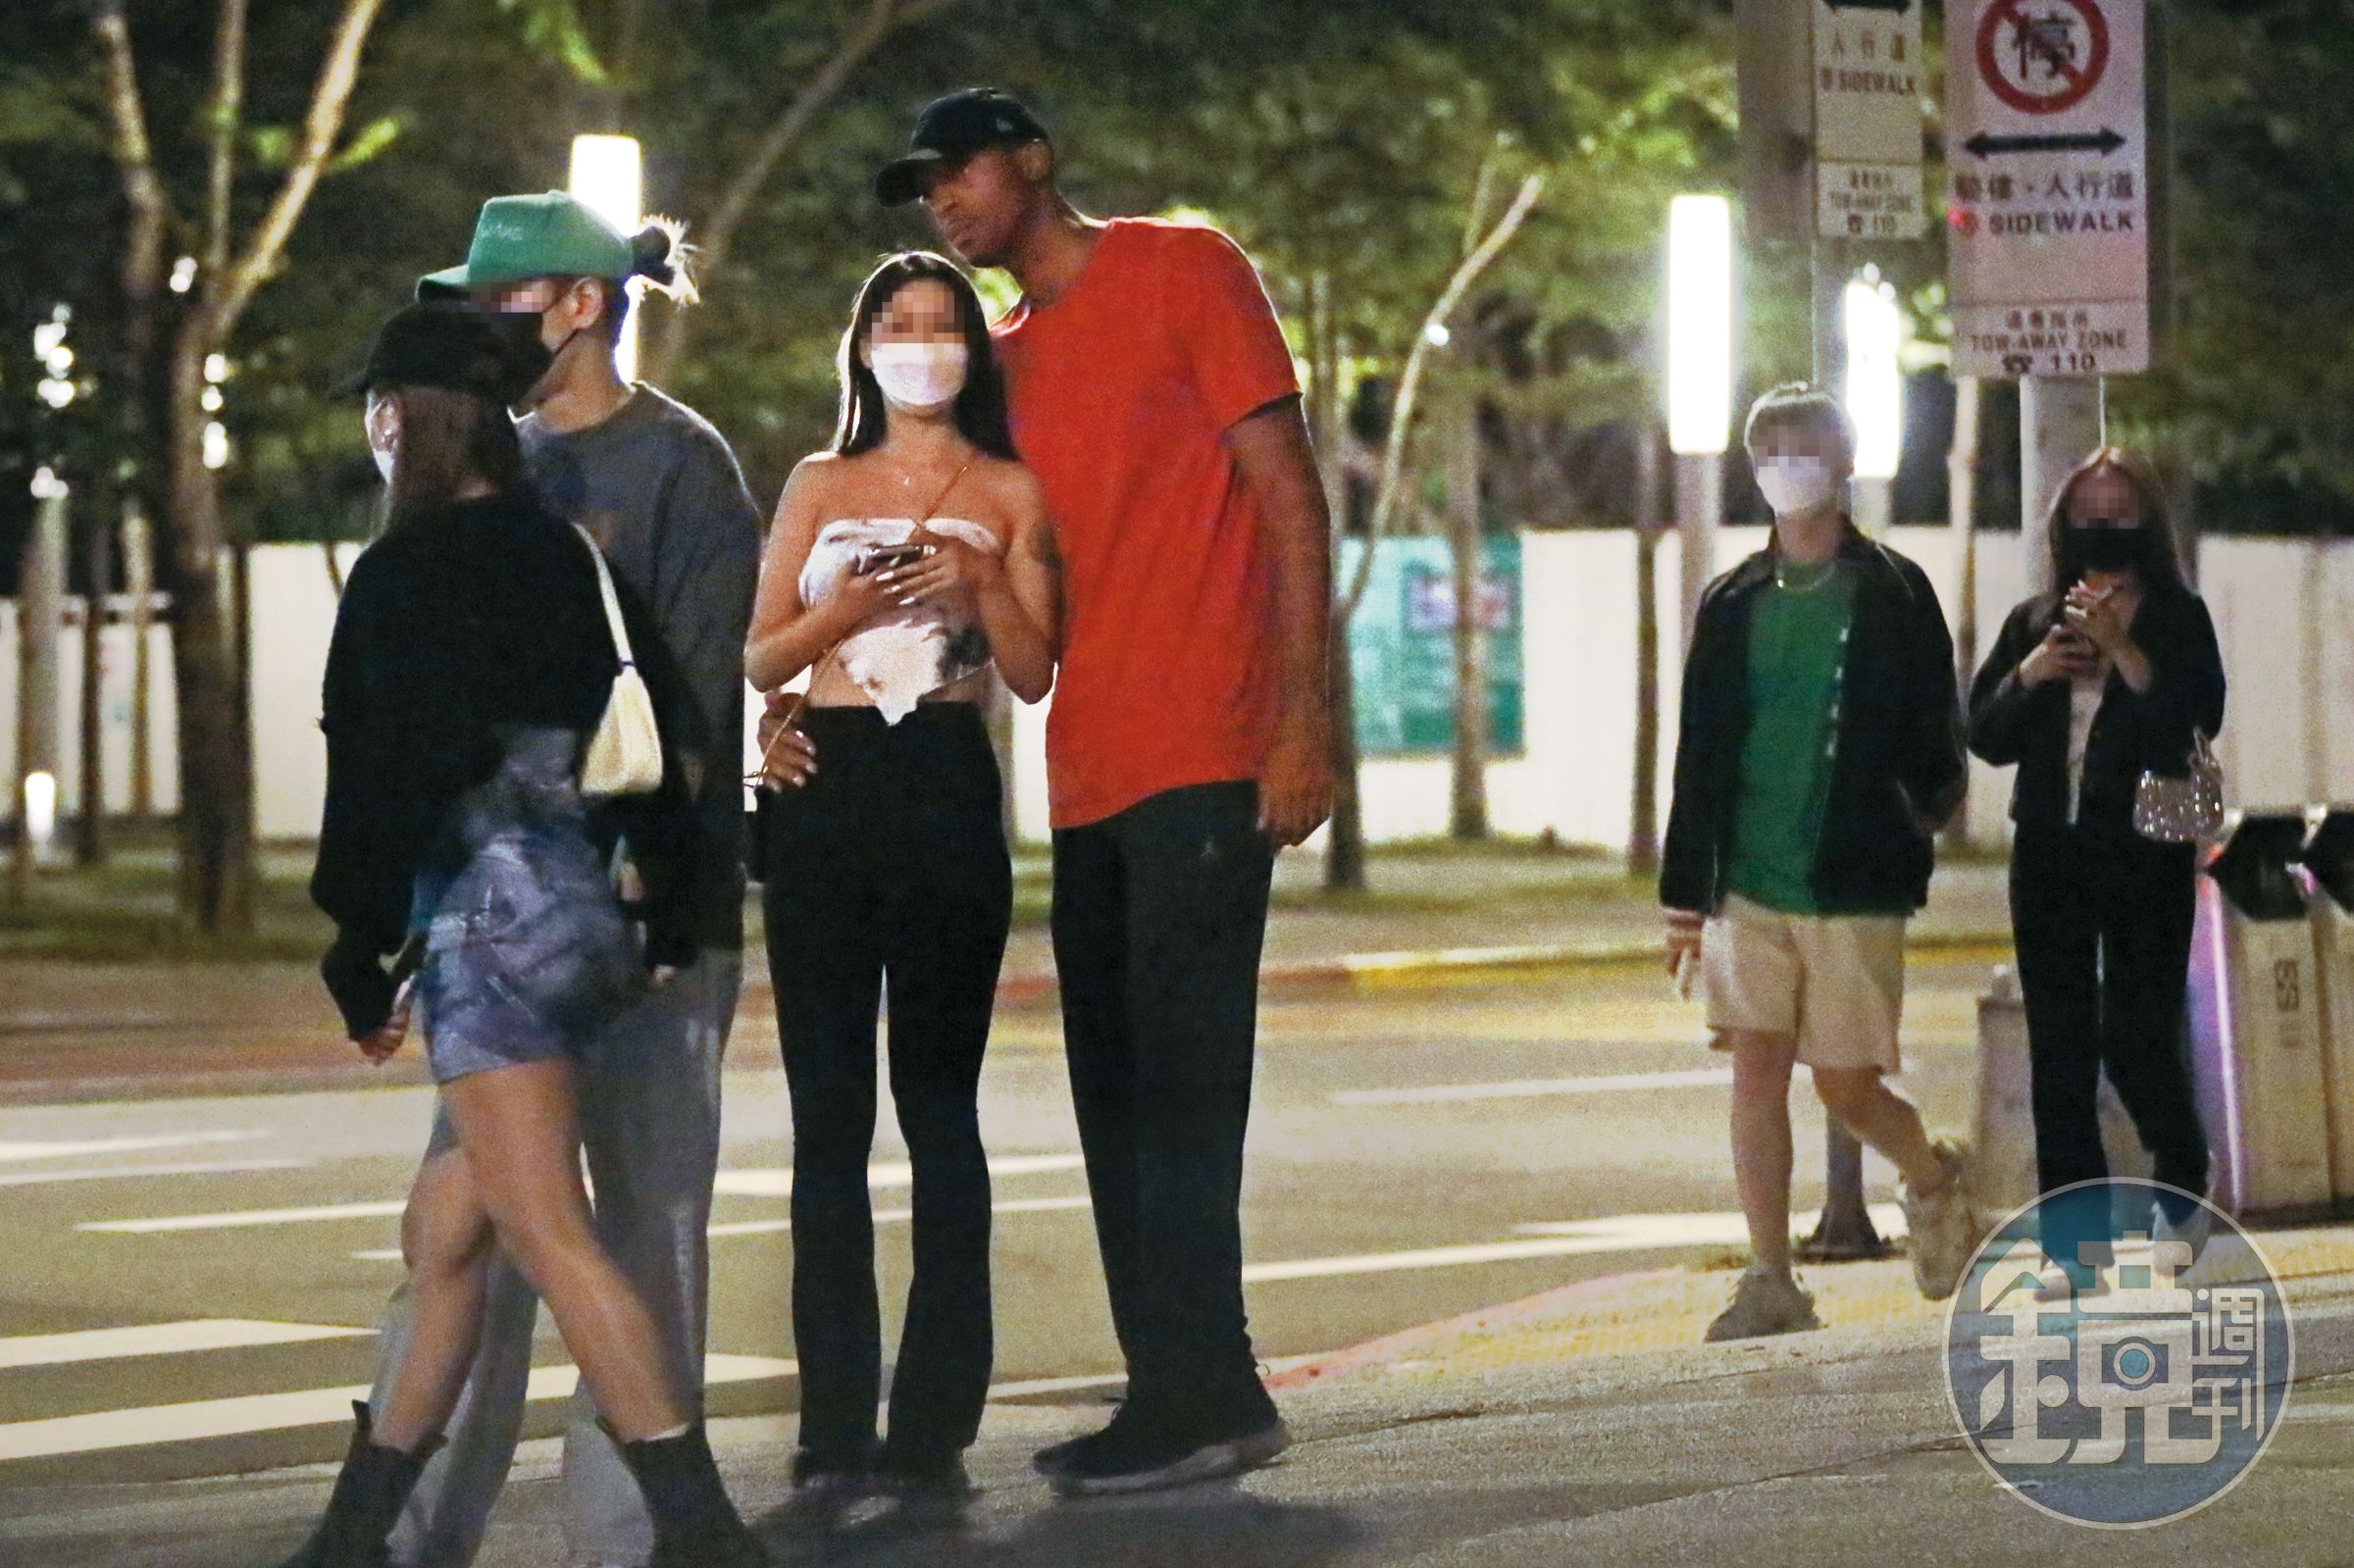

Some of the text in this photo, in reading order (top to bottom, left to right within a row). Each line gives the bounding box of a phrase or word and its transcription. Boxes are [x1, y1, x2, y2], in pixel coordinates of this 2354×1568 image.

[1838, 70, 1917, 96] SIDEWALK
[1989, 211, 2133, 235] SIDEWALK
[2078, 329, 2127, 349] ZONE
[2052, 352, 2096, 374] 110
